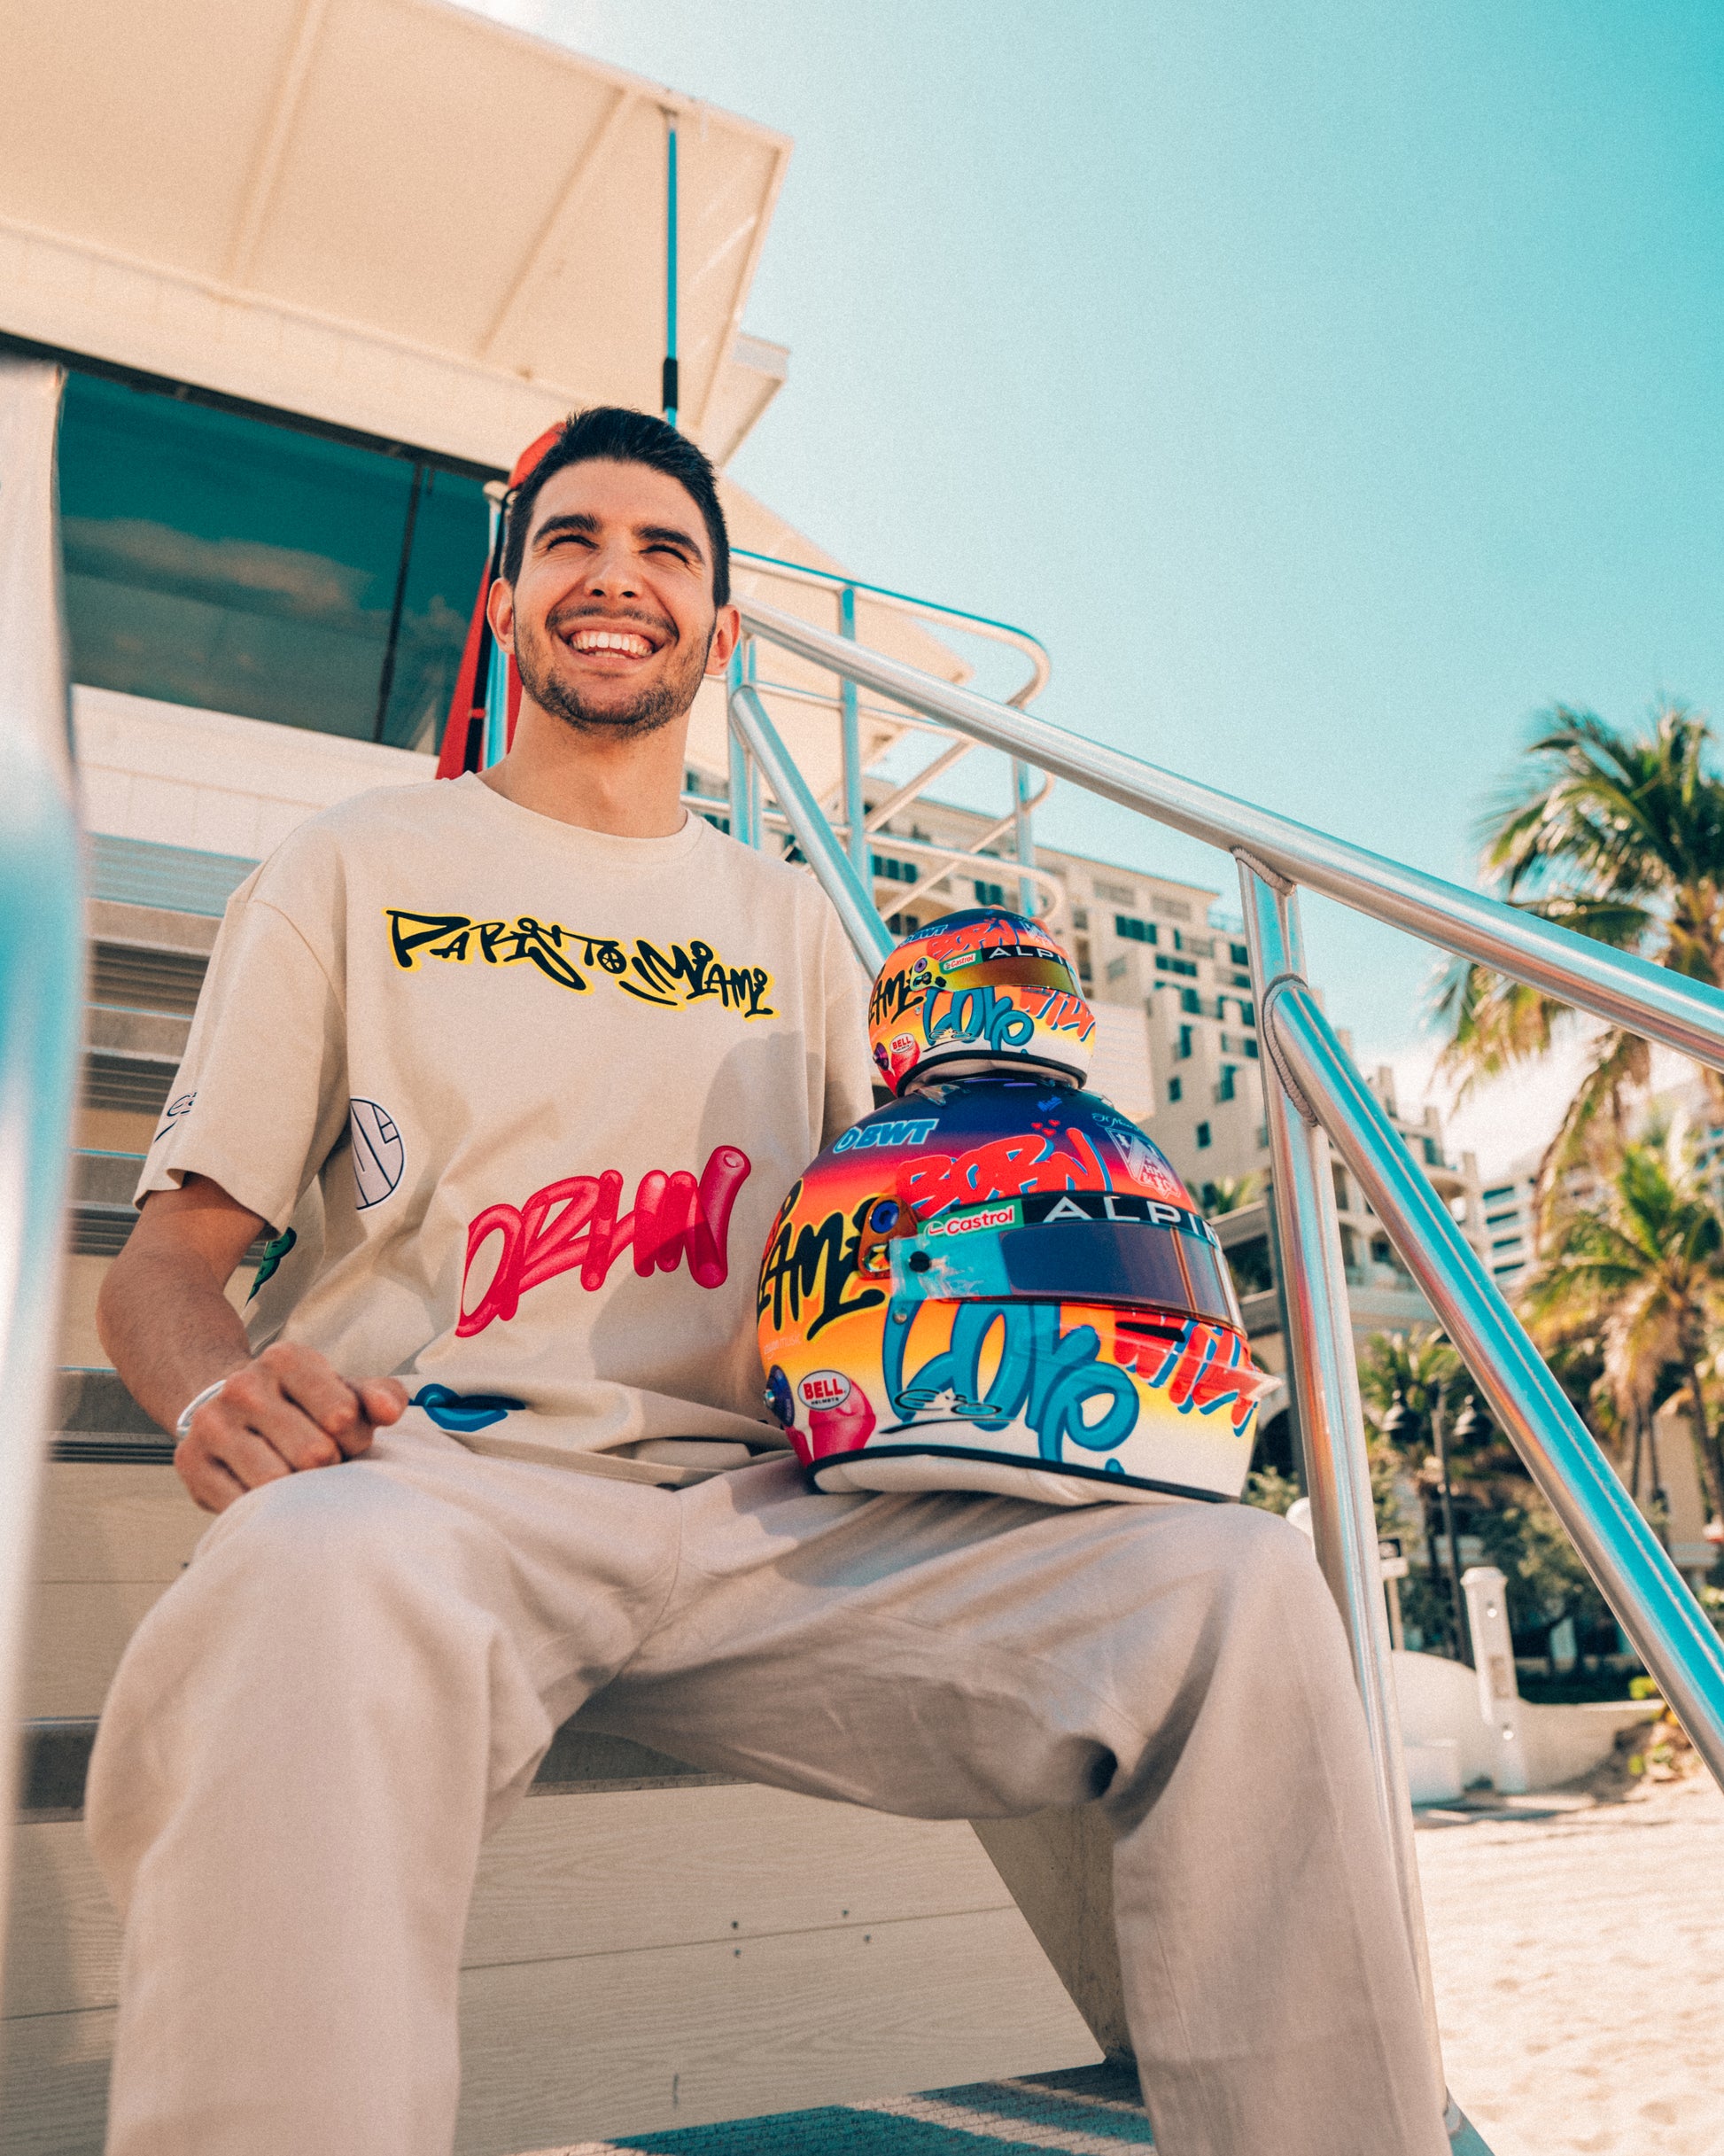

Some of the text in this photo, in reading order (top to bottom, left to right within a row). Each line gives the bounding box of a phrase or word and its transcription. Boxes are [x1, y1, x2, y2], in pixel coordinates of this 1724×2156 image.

[892, 1036, 912, 1050] BELL
[851, 1118, 940, 1150] BWT
[944, 1206, 1015, 1237] Castrol
[803, 1378, 844, 1400] BELL
